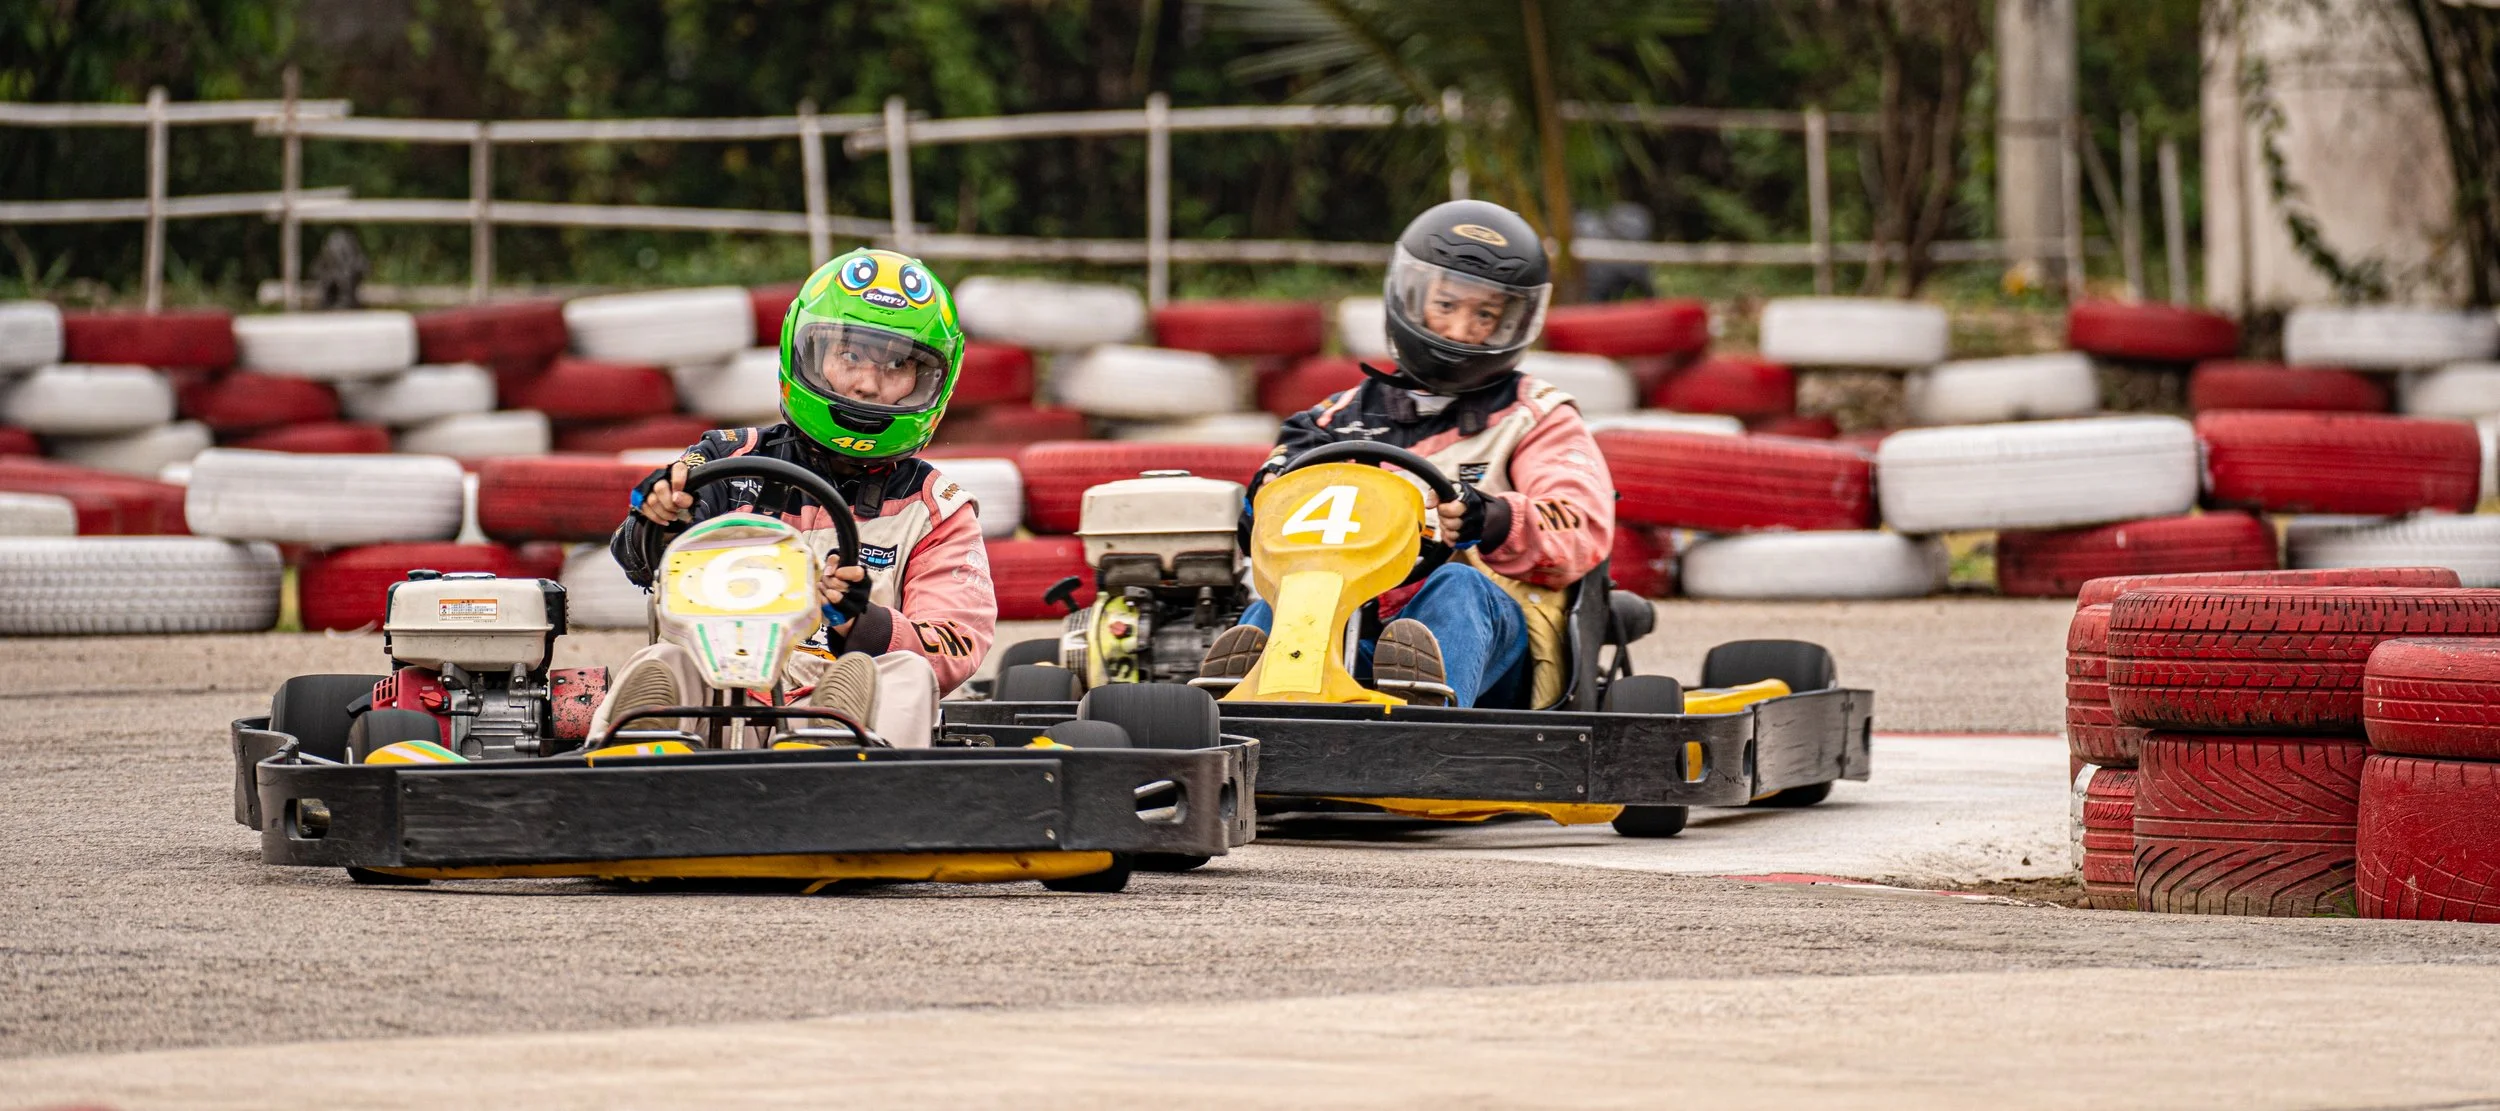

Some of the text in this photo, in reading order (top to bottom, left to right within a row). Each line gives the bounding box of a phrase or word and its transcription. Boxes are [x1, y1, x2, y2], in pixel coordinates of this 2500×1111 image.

[831, 436, 877, 451] 46
[1281, 485, 1361, 544] 4
[858, 547, 895, 559] oPro
[701, 544, 787, 610] 6
